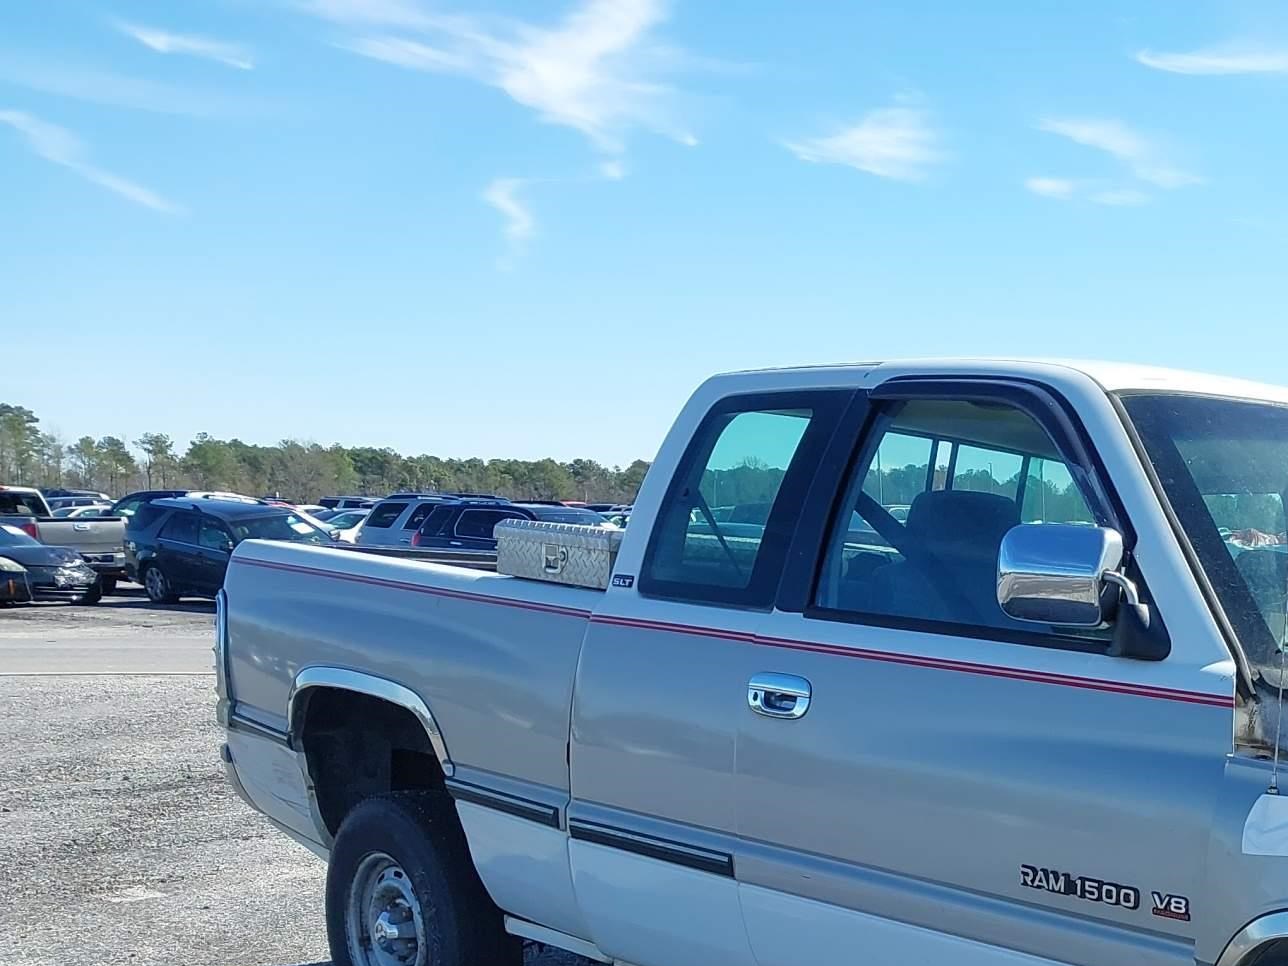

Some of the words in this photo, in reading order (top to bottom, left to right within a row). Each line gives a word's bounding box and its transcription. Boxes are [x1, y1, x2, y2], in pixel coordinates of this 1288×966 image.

[613, 577, 633, 587] SLT
[1020, 864, 1069, 894] RAM
[1075, 876, 1139, 909] 1500
[1152, 891, 1189, 914] V8
